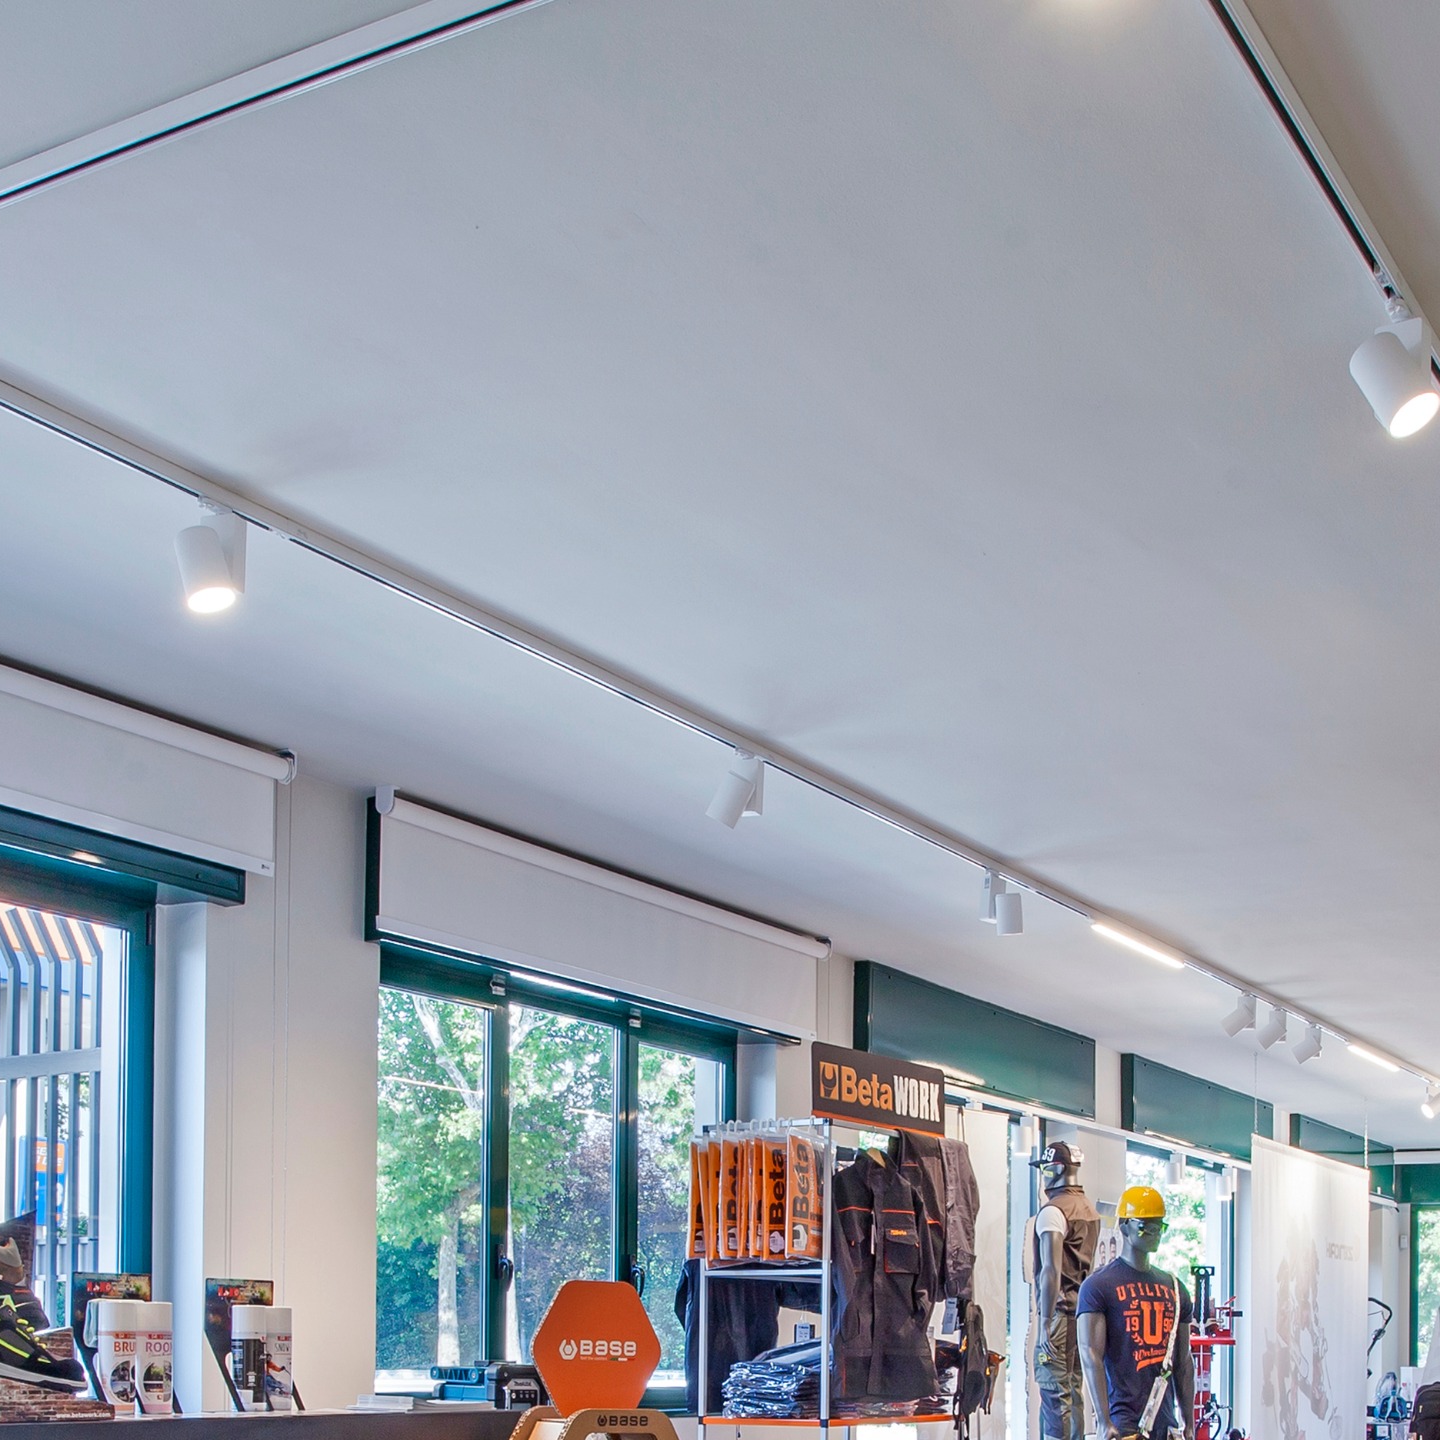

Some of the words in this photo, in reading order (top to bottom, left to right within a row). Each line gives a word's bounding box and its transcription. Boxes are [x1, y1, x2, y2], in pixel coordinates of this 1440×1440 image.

[769, 1149, 785, 1225] Beta
[793, 1143, 810, 1219] Beta
[1125, 1317, 1140, 1332] 19
[1140, 1301, 1165, 1345] U
